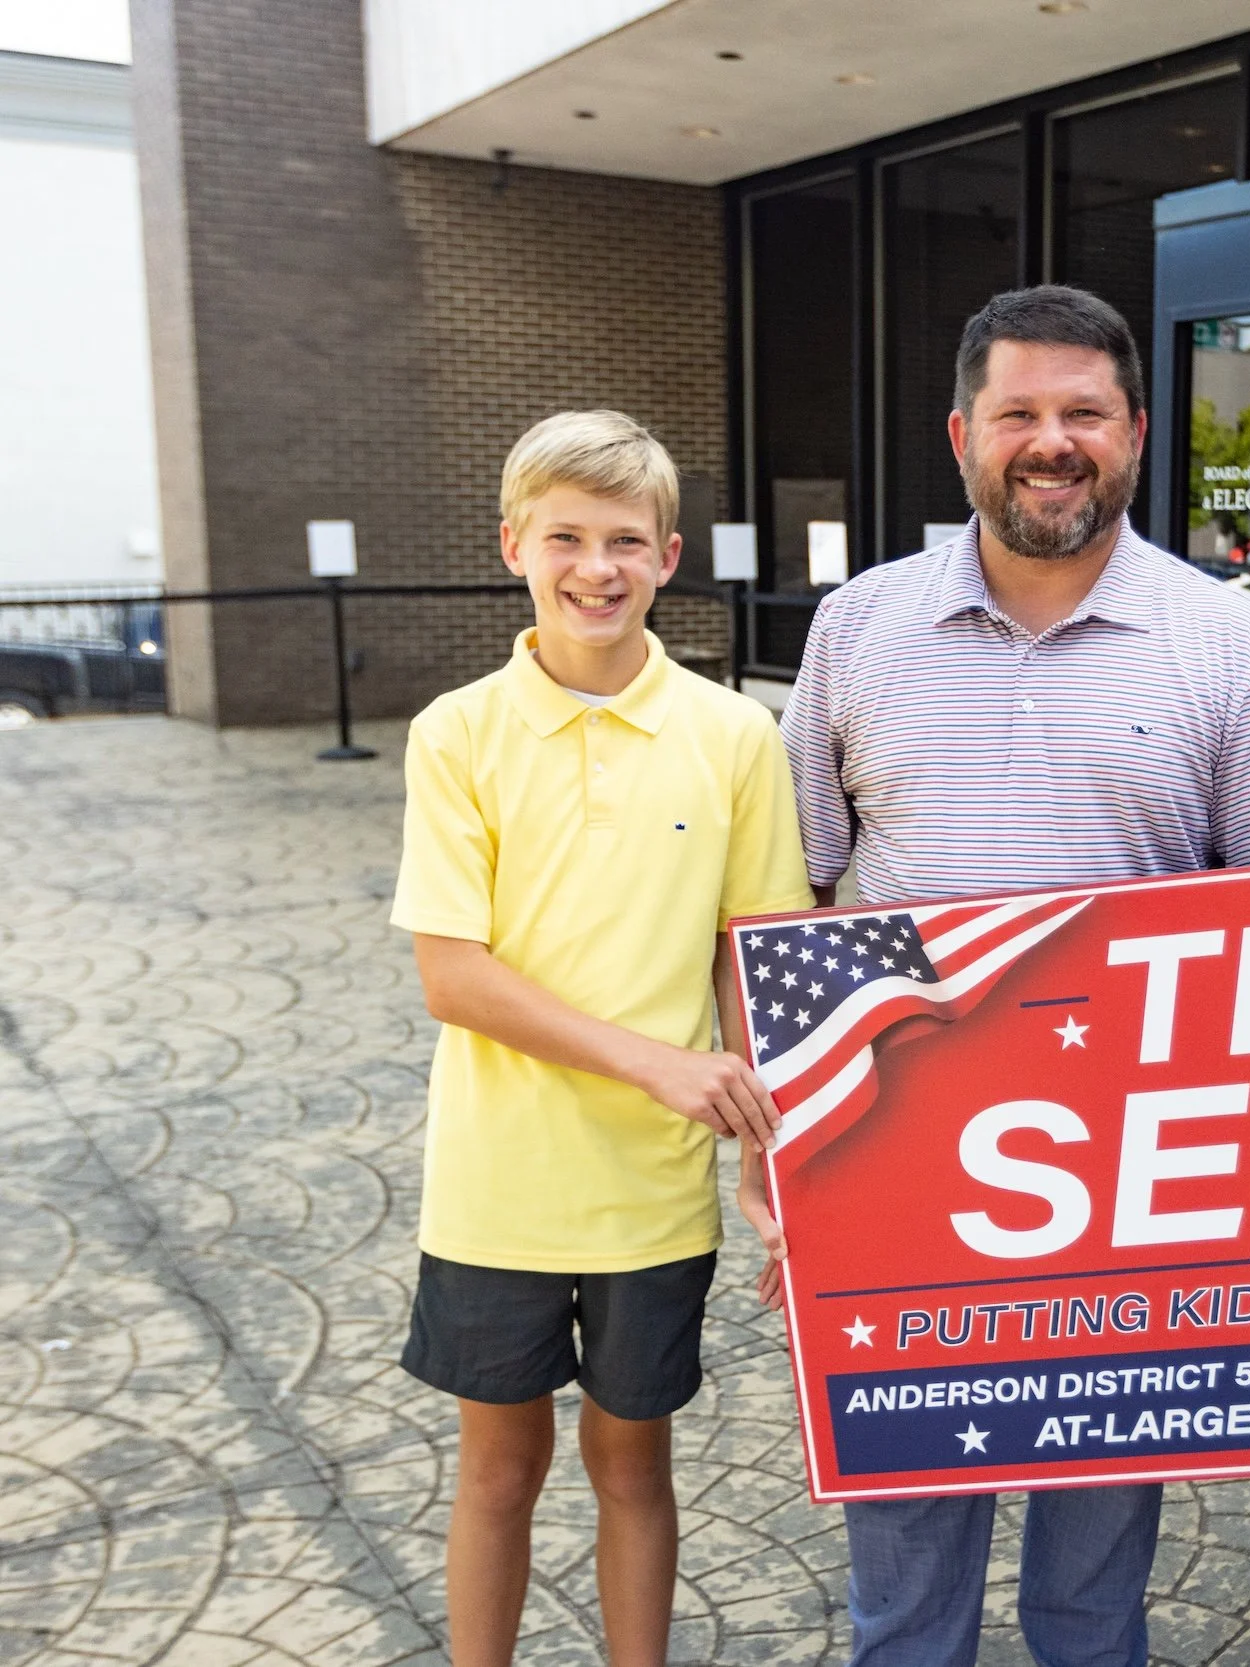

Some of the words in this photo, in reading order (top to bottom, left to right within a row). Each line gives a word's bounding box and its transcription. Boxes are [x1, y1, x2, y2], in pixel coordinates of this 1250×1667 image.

[1204, 466, 1241, 481] BOARD
[896, 1292, 1149, 1350] PUTTING
[846, 1376, 1047, 1414] ANDERSON
[1058, 1362, 1224, 1399] DISTRICT
